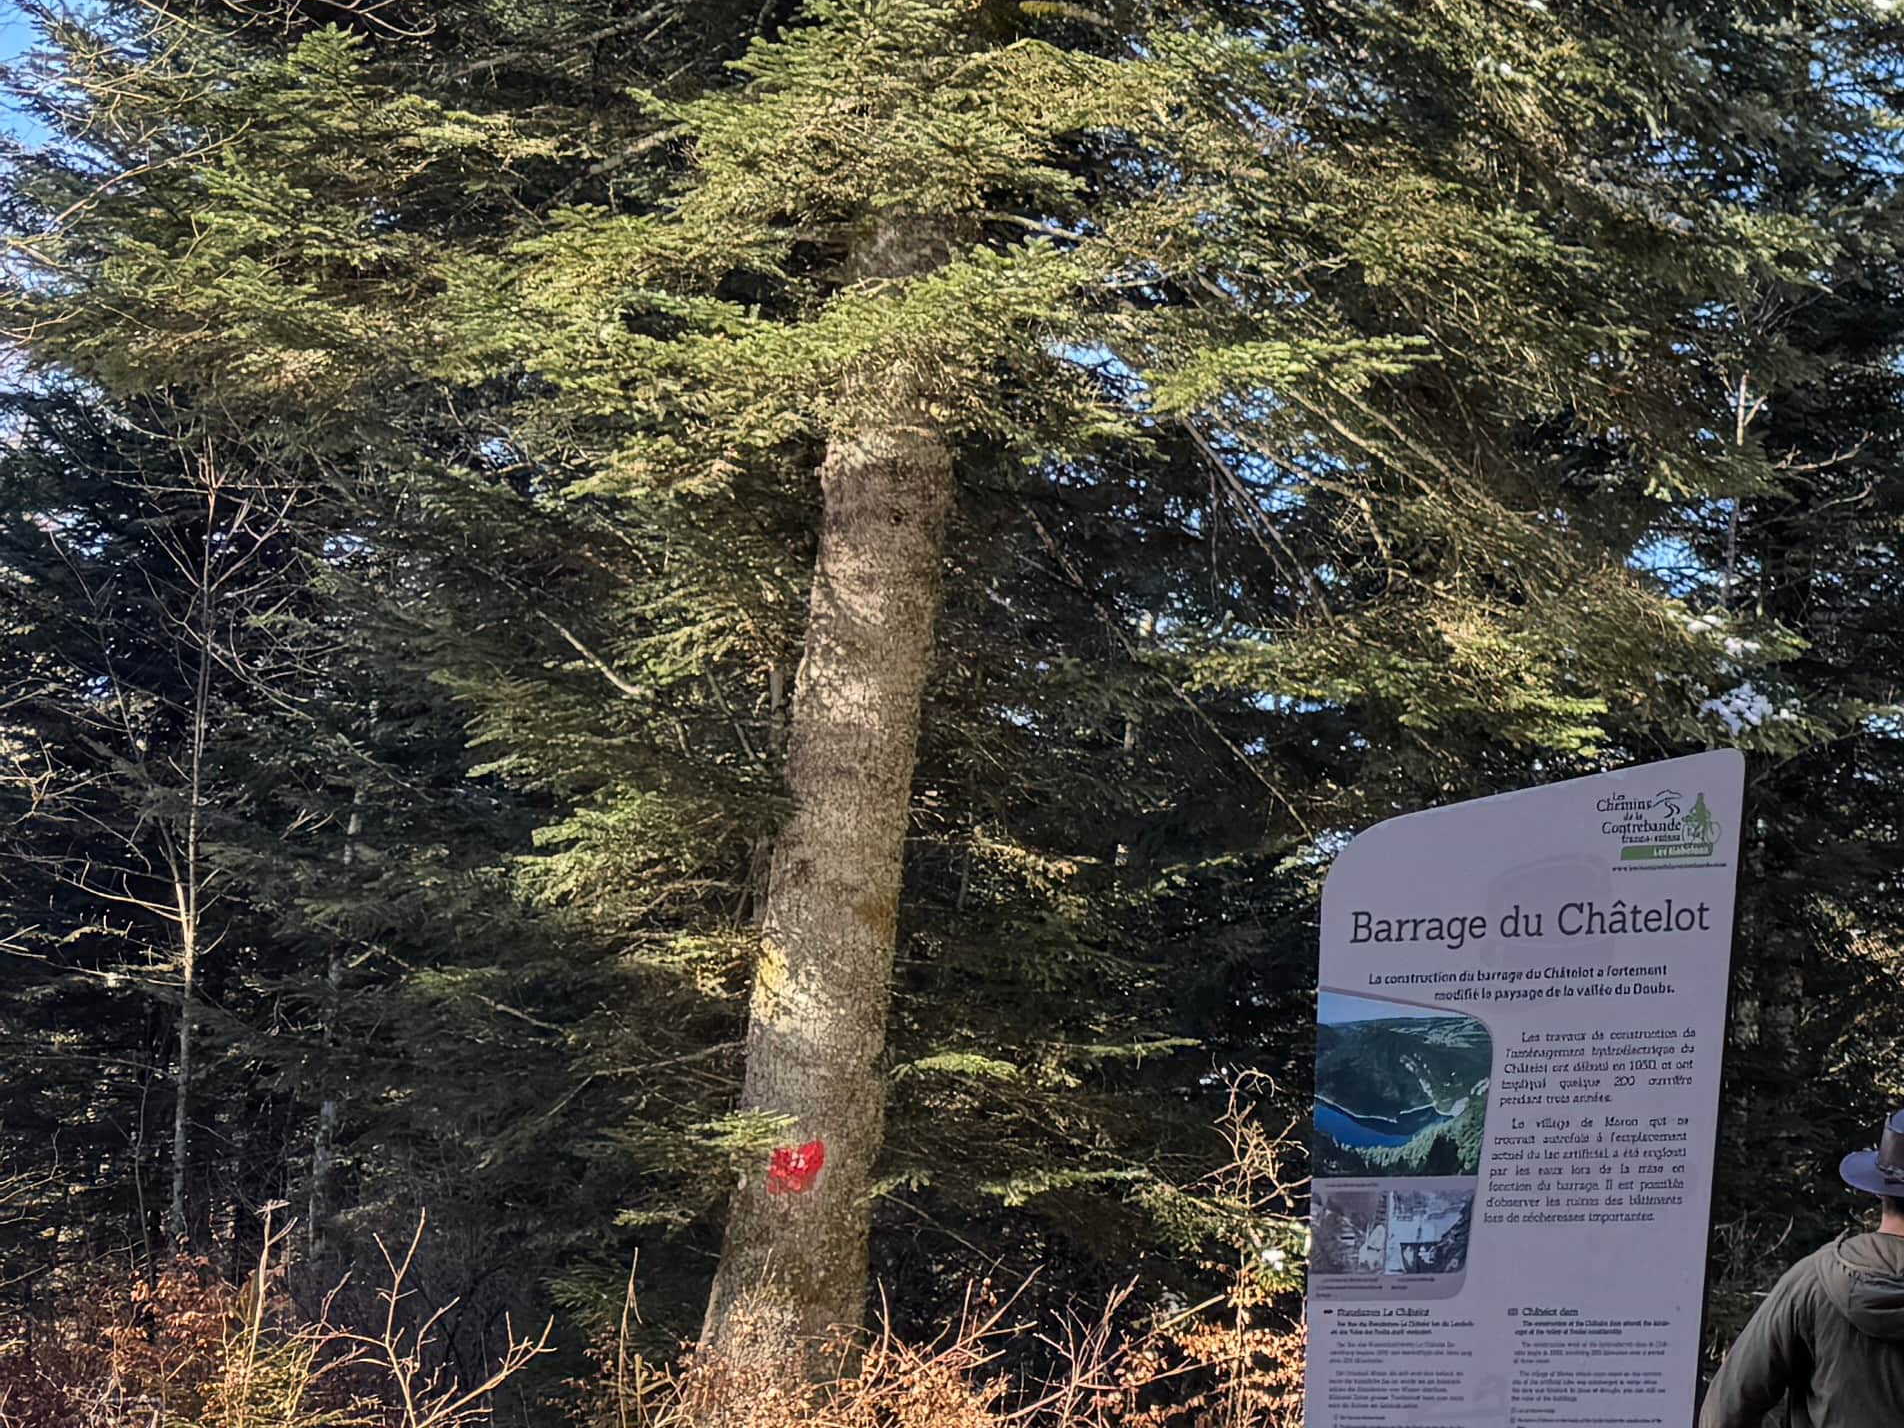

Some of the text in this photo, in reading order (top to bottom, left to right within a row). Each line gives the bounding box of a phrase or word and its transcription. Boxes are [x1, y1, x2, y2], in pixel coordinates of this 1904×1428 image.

[1596, 799, 1652, 812] Chemins
[1602, 820, 1681, 835] Contrebande
[1351, 899, 1711, 949] Barrage du Châtelot
[1369, 964, 1667, 985] La construction du barrage du Châtelot a fortement
[1434, 989, 1479, 1001] modifié
[1494, 988, 1543, 1002] paysage
[1546, 986, 1561, 998] de
[1577, 985, 1612, 997] vallée
[1615, 984, 1631, 995] du
[1521, 1028, 1696, 1043] Les travaux de construction de
[1613, 1062, 1626, 1071] en
[1676, 1059, 1693, 1070] ont
[1614, 1076, 1636, 1087] 200
[1500, 1094, 1542, 1108] pendant
[1581, 1118, 1593, 1128] de
[1649, 1117, 1666, 1128] qui
[1527, 1149, 1540, 1160] du
[1489, 1167, 1508, 1179] par
[1515, 1166, 1530, 1176] les
[1599, 1164, 1612, 1174] de
[1620, 1164, 1630, 1174] la
[1672, 1165, 1685, 1173] en
[1488, 1181, 1532, 1192] fonction
[1537, 1181, 1550, 1191] du
[1618, 1180, 1634, 1190] est
[1545, 1196, 1560, 1207] les
[1566, 1196, 1599, 1206] ruines
[1604, 1195, 1623, 1206] des
[1506, 1212, 1520, 1223] de
[1522, 1211, 1585, 1222] sécheresses
